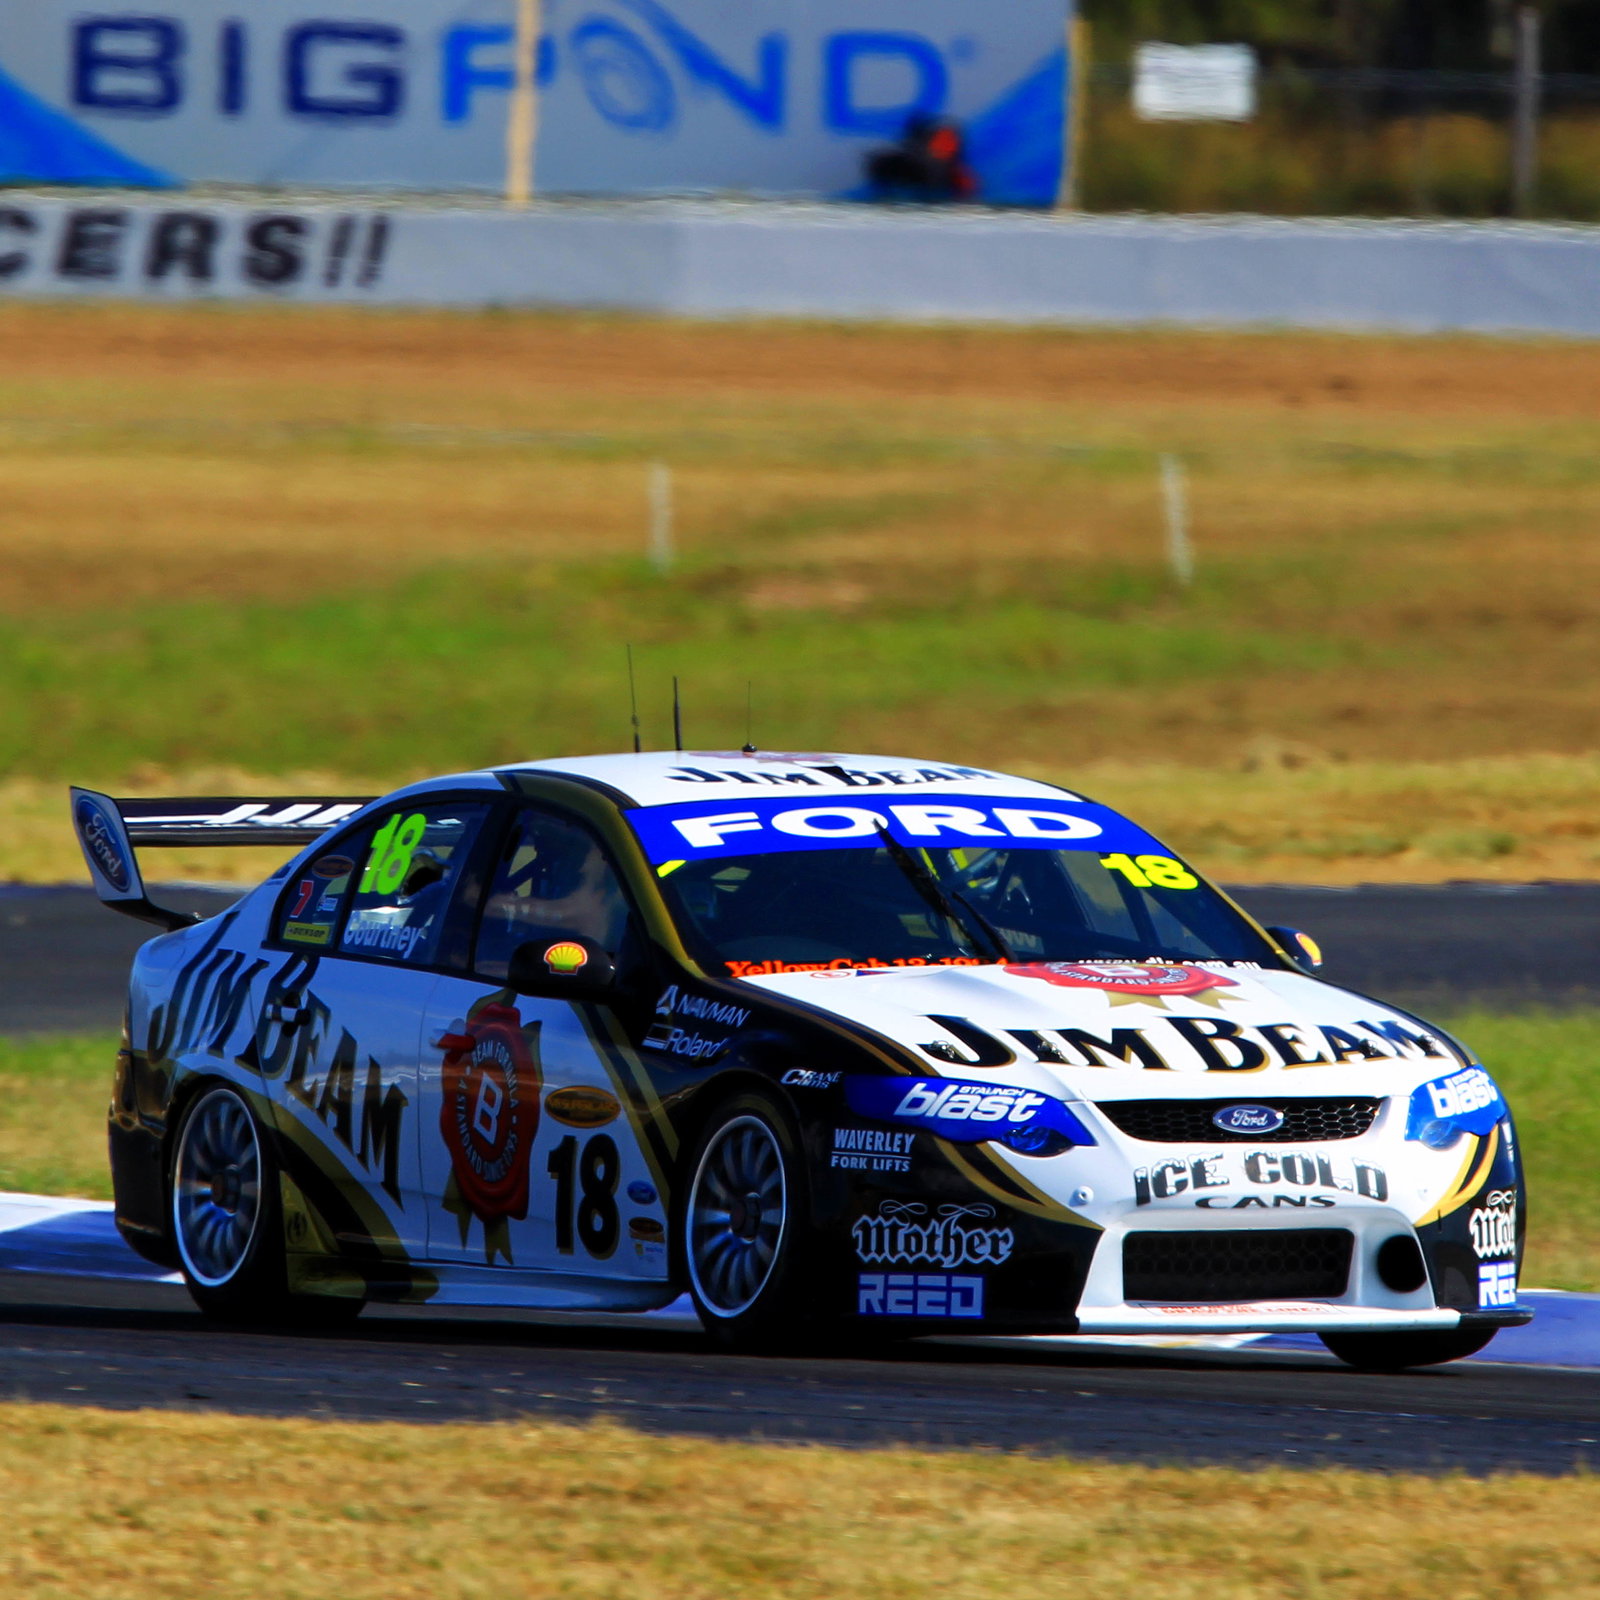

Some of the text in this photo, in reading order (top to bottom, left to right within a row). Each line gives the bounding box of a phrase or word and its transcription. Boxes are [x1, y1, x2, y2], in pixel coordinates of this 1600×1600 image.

[665, 764, 999, 787] JIM BEAM
[84, 812, 123, 878] Ford
[671, 804, 1104, 849] FORD
[357, 812, 427, 896] 18
[1099, 852, 1199, 891] 18
[289, 879, 315, 918] 7
[343, 914, 422, 959] Courtney
[676, 993, 752, 1028] NAVMAN
[147, 910, 409, 1213] JIM BEAM
[668, 1027, 729, 1058] Roland
[912, 1014, 1452, 1075] JIM BEAM
[472, 1070, 504, 1146] B
[893, 1082, 1046, 1123] blast
[958, 1085, 1027, 1097] STAUNCH
[1426, 1070, 1499, 1119] blast
[1230, 1108, 1270, 1128] Ford
[830, 1155, 911, 1172] FORK LIFTS
[833, 1128, 916, 1154] WAVERLEY
[547, 1132, 622, 1261] 18
[1133, 1148, 1390, 1206] ICE COLD
[1194, 1194, 1336, 1209] CANS
[852, 1201, 1015, 1268] Mother
[858, 1273, 984, 1318] REED
